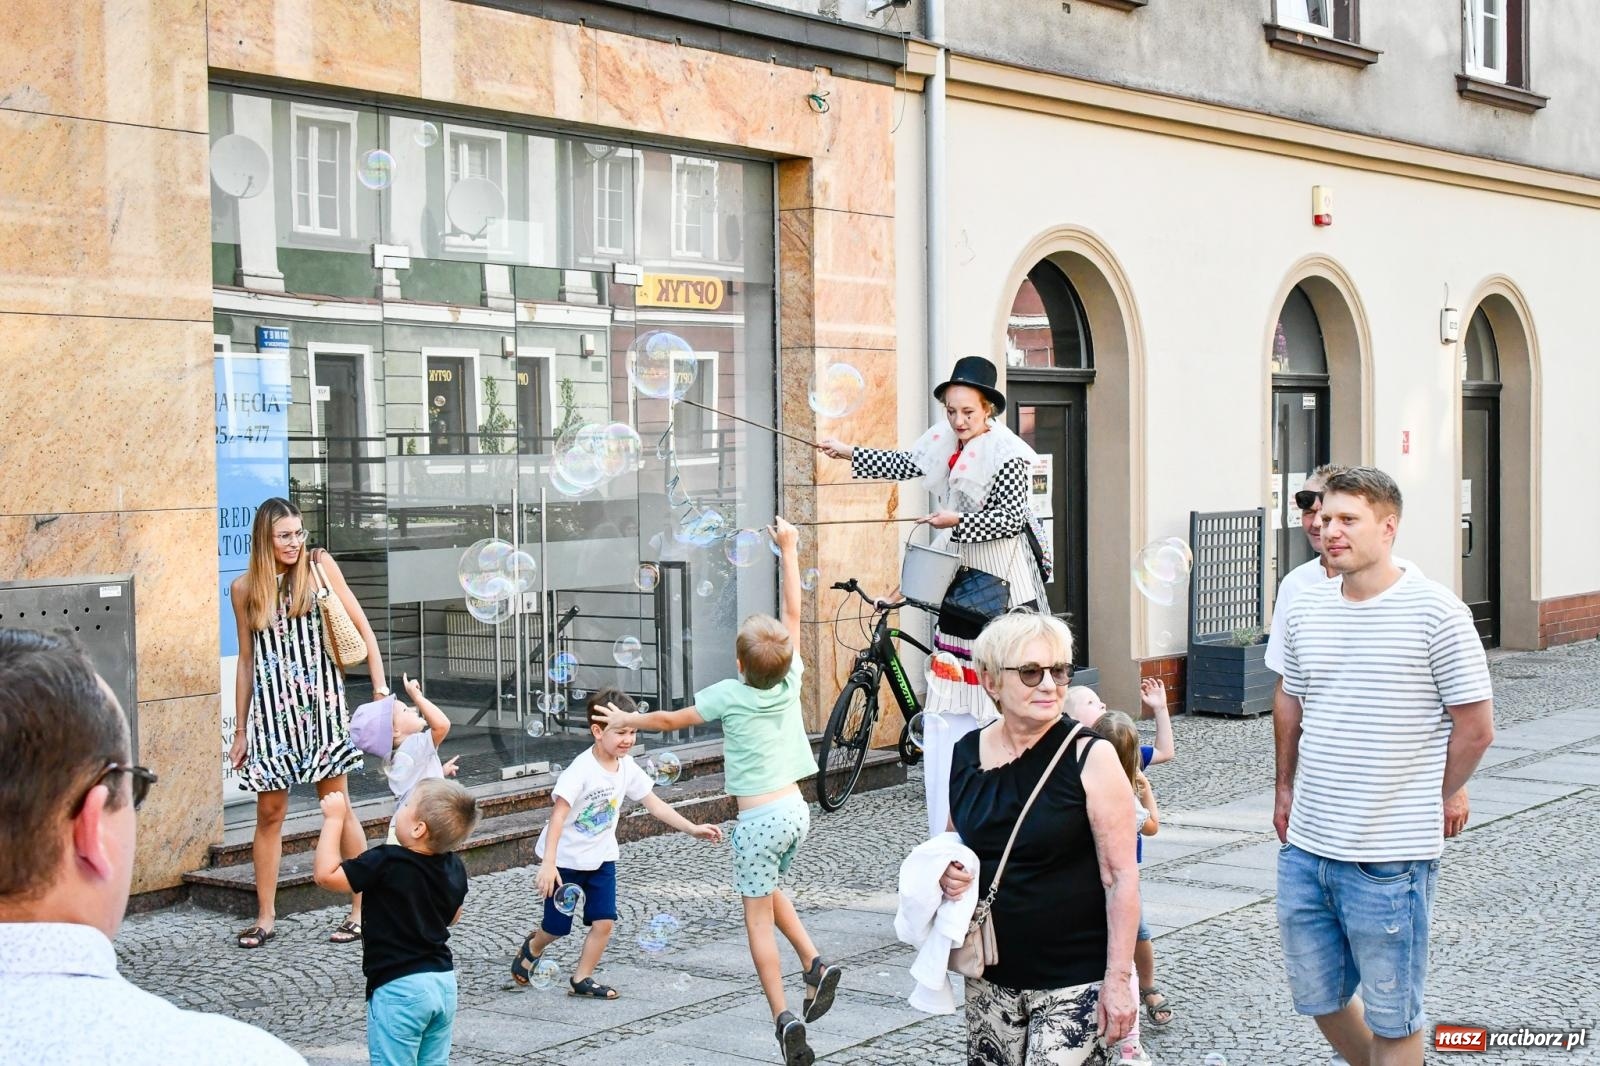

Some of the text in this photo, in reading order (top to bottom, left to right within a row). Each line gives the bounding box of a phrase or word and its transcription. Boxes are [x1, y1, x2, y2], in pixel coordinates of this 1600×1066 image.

[215, 392, 281, 417] AJĘCIA
[220, 506, 258, 528] RED
[218, 534, 251, 556] TOR
